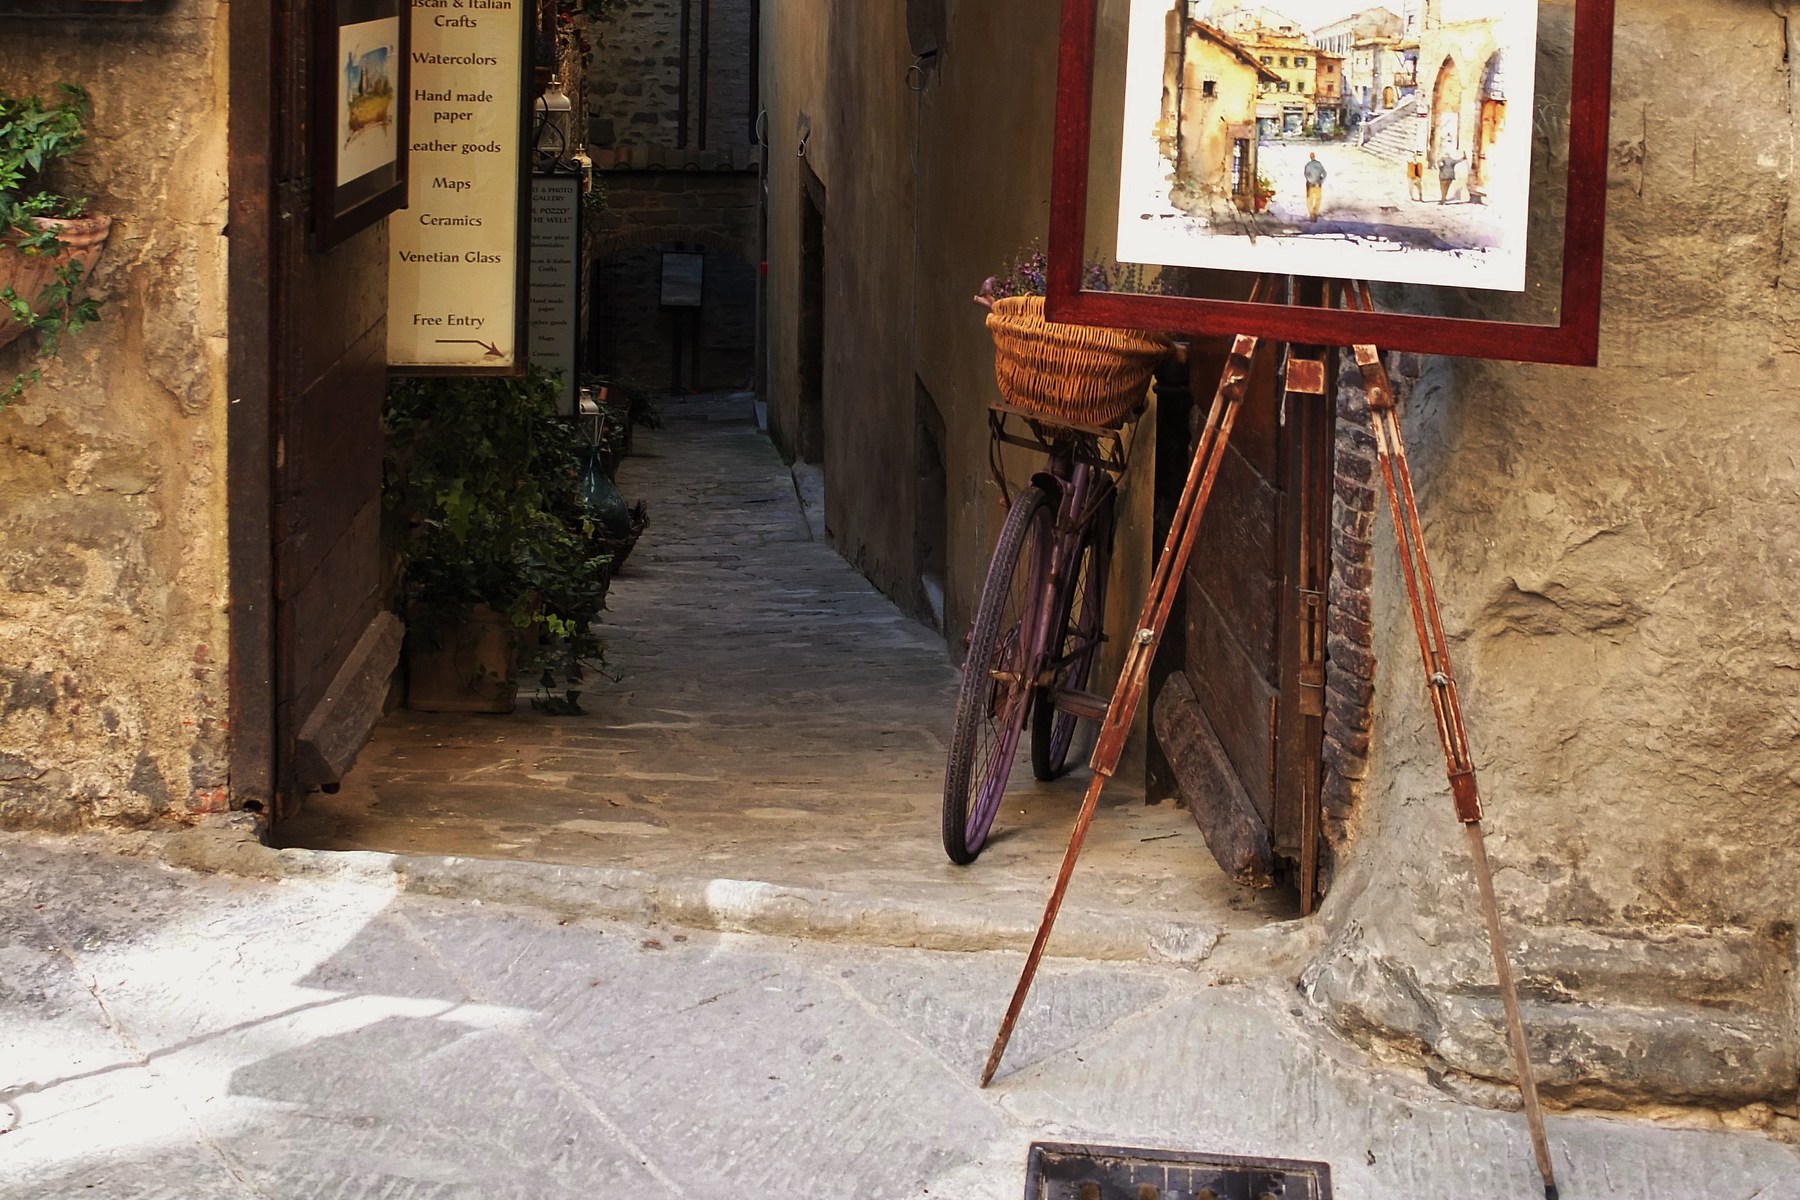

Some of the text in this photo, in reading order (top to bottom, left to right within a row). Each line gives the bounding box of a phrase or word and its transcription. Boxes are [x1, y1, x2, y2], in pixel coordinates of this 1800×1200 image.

[434, 14, 478, 28] Crafts
[411, 52, 498, 66] Watercolors
[414, 89, 493, 103] Hand made
[433, 110, 474, 123] paper
[461, 141, 502, 155] goods
[432, 176, 472, 193] Maps
[419, 213, 482, 227] Ceramics
[399, 250, 502, 264] Venetian Glass
[413, 313, 485, 330] Free Entry
